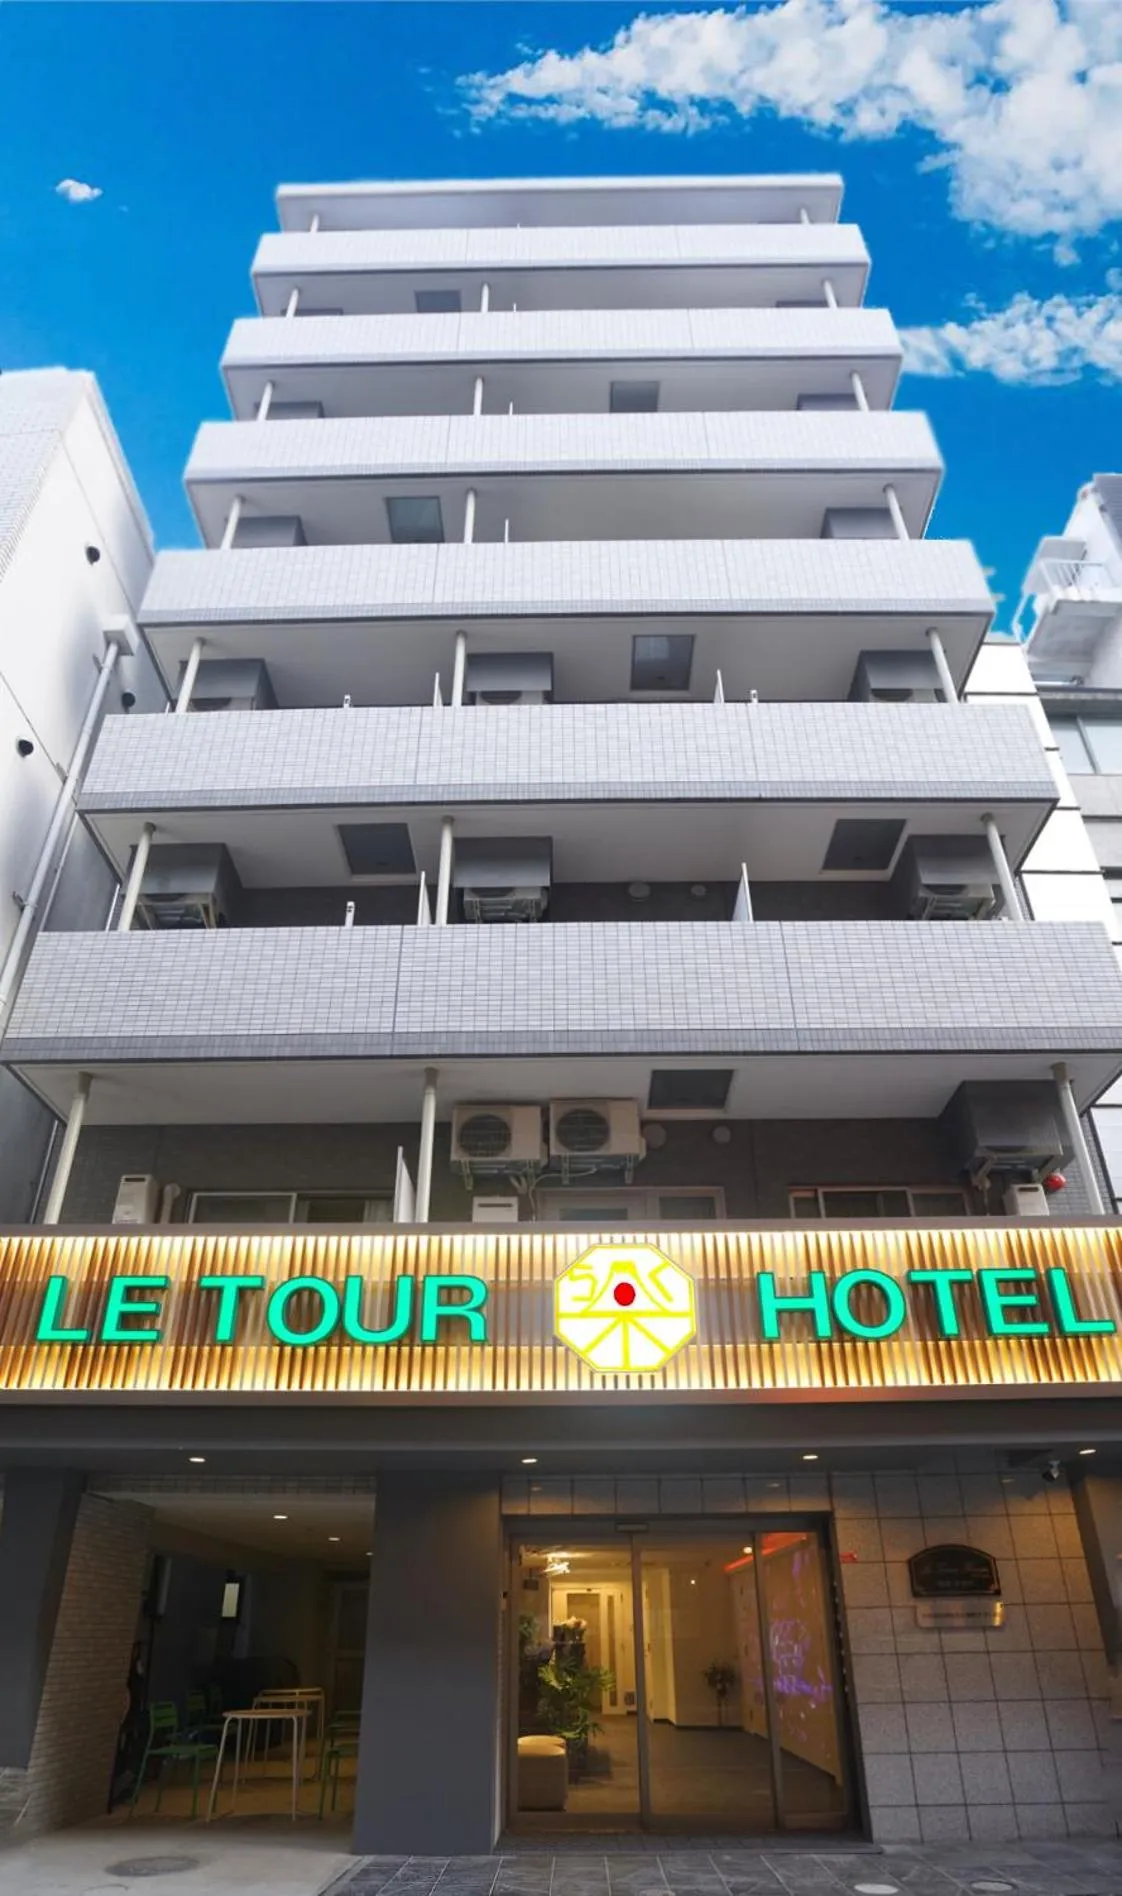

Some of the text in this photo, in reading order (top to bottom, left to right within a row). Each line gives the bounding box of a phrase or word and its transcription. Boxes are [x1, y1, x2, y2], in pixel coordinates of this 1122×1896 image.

[35, 1267, 1117, 1347] LE TOUR HOTEL
